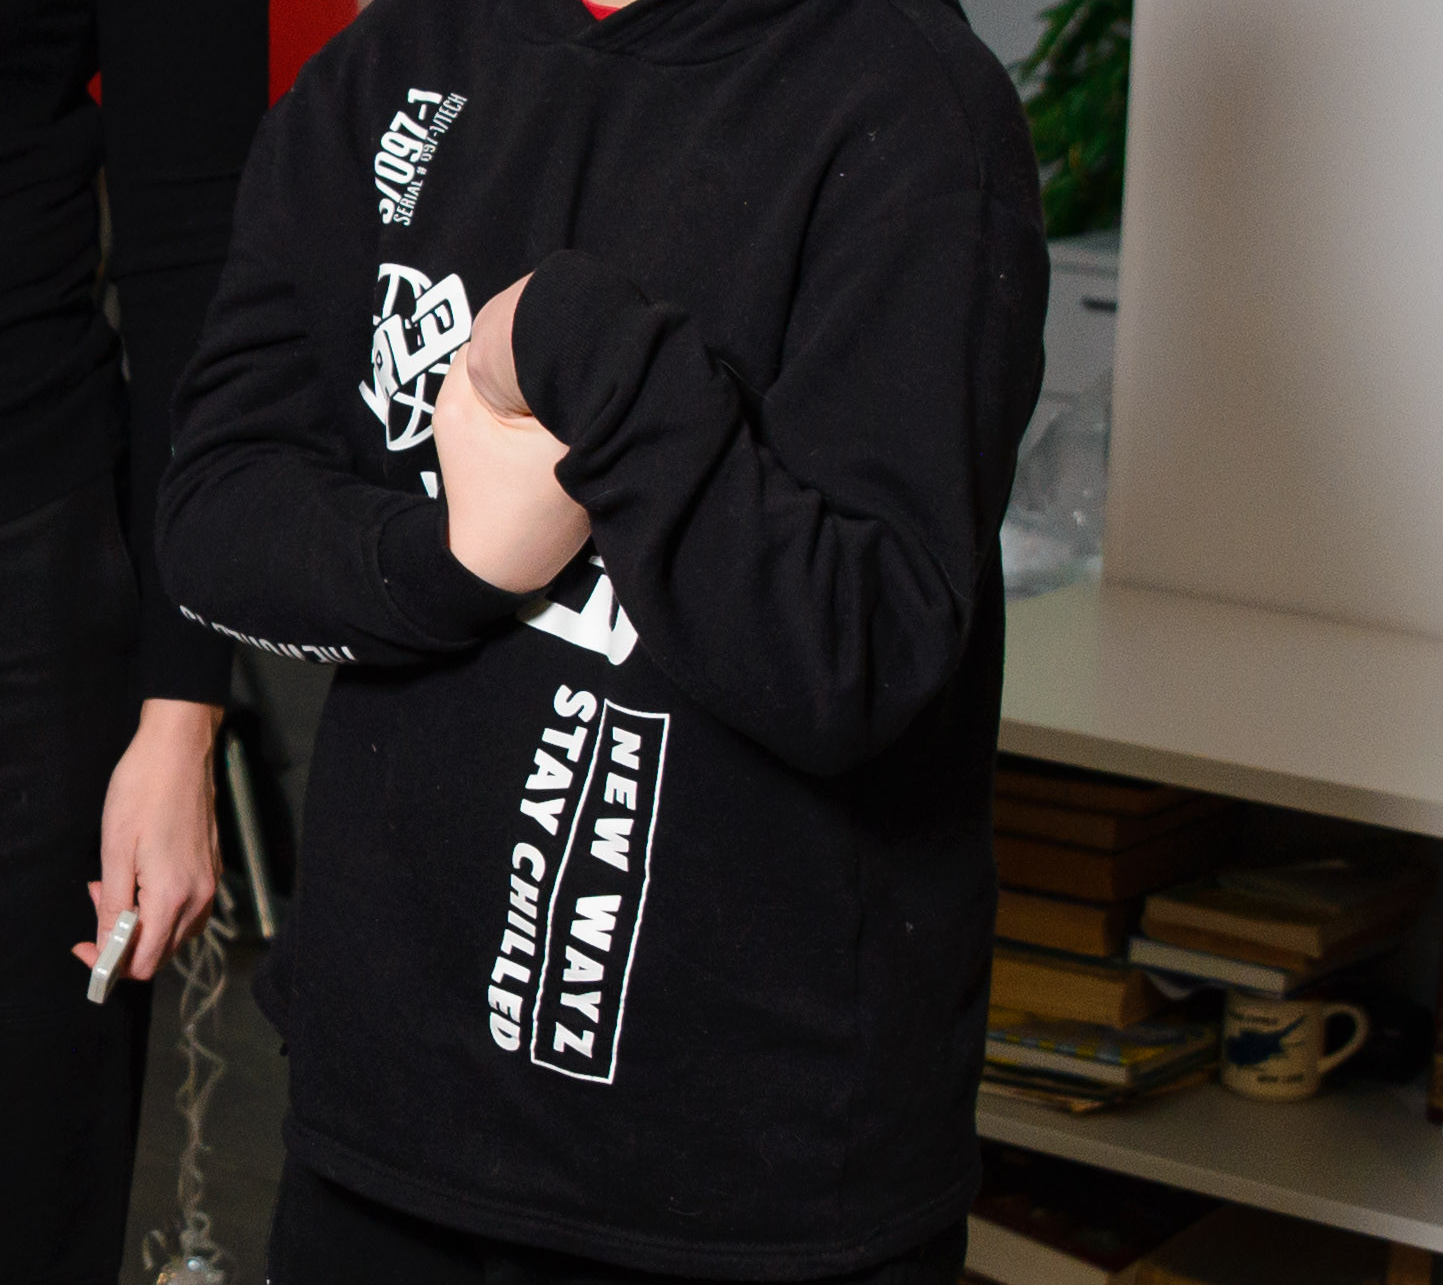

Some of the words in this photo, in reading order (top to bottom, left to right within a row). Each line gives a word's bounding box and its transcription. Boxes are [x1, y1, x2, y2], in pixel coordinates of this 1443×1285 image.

[393, 179, 424, 227] SERIAL
[416, 165, 428, 176] #
[519, 684, 598, 836] STAY
[590, 726, 642, 873] NEW
[487, 842, 546, 1052] CHILLED
[553, 894, 623, 1059] WAYZ
